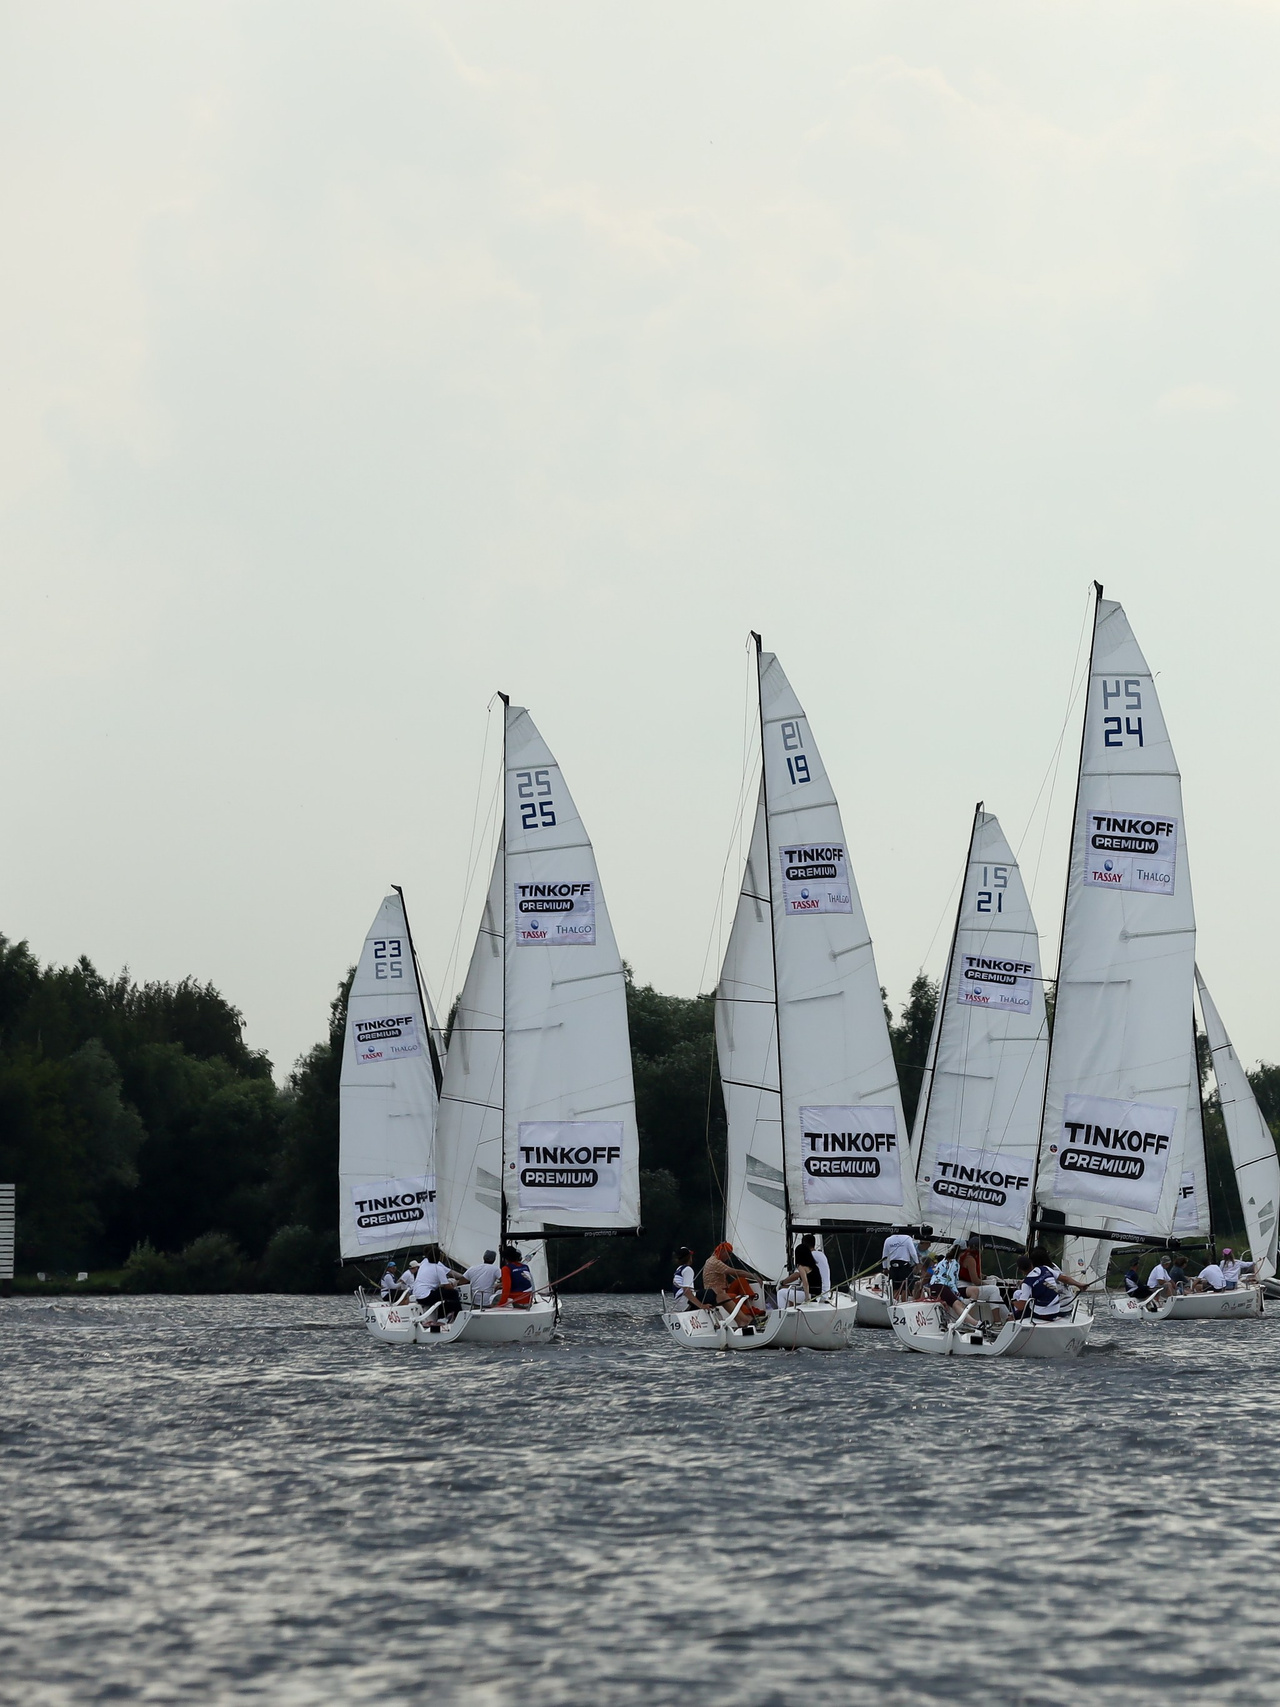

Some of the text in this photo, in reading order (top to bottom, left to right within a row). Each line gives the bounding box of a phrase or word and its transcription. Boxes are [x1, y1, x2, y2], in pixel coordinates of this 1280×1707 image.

[1104, 716, 1143, 747] 24
[786, 755, 810, 784] 19
[520, 801, 556, 829] 25
[1092, 816, 1173, 836] TINKOFF
[1095, 838, 1156, 852] PREMIUM
[784, 848, 844, 864] TINKOFF
[790, 867, 836, 878] PREMIUM
[1092, 869, 1170, 883] TASSAY THALGO
[518, 884, 590, 896] TINKOFF
[522, 901, 571, 911] PREMIUM
[791, 900, 820, 910] TASSAY
[977, 892, 1002, 912] 21
[521, 924, 592, 939] TASSAY THALGO
[374, 940, 402, 958] 23
[966, 956, 1032, 974] TINKOFF
[968, 971, 1015, 984] PREMIUM
[964, 994, 1030, 1006] TASSAY THALGO
[355, 1016, 413, 1032] TINKOFF
[360, 1030, 400, 1041] PREMIUM
[362, 1052, 383, 1060] TASSAY
[804, 1132, 896, 1152] TINKOFF
[1064, 1122, 1169, 1155] TINKOFF
[520, 1146, 620, 1164] TINKOFF
[810, 1160, 876, 1174] PREMIUM
[1064, 1152, 1142, 1176] PREMIUM
[525, 1172, 594, 1184] PREMIUM
[938, 1162, 1029, 1190] TINKOFF
[355, 1190, 436, 1212] TINKOFF
[938, 1182, 1003, 1204] PREMIUM
[362, 1210, 420, 1226] PREMIUM
[670, 1322, 680, 1330] 19
[893, 1316, 906, 1326] 24
